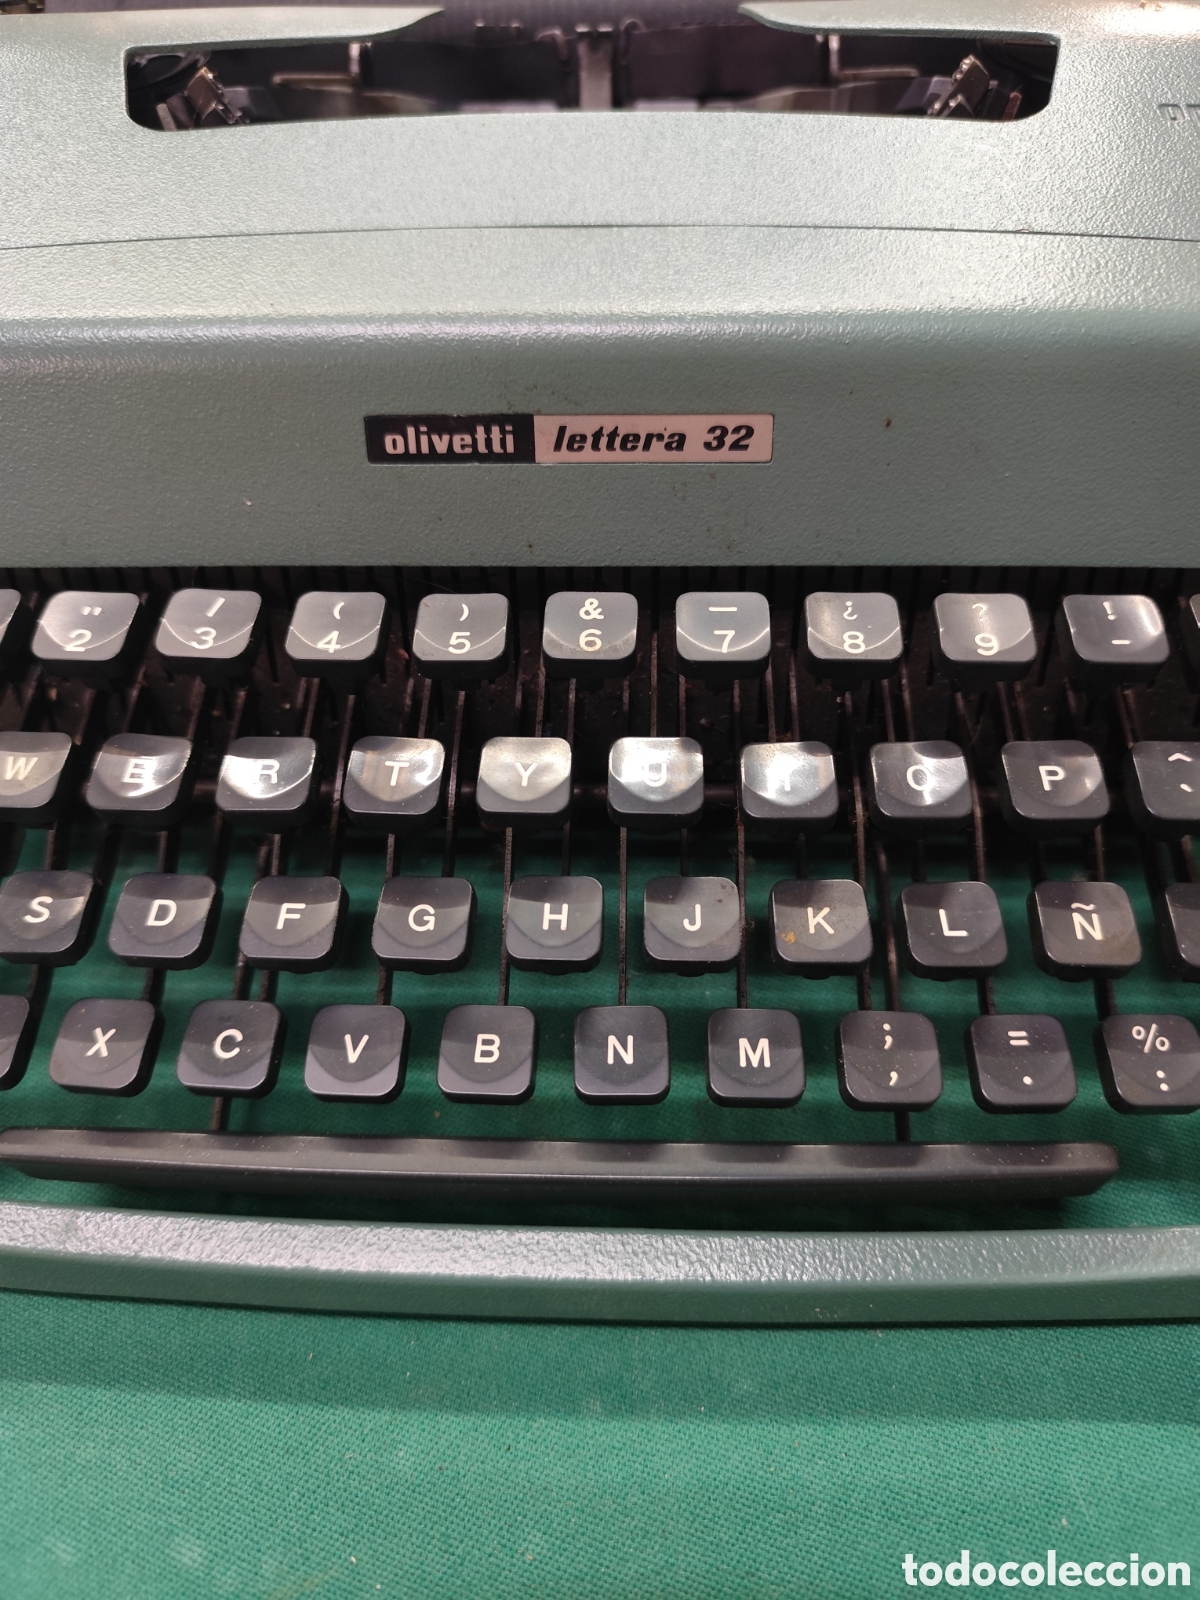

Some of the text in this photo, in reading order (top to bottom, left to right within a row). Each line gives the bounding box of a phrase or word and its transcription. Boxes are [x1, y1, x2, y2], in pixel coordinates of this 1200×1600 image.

[384, 424, 515, 455] olivetti
[553, 425, 755, 452] lettera 32
[333, 601, 345, 619] (
[460, 604, 469, 622] )
[578, 597, 605, 620] &
[843, 600, 858, 620] ¿
[1102, 601, 1116, 620] !
[65, 629, 92, 652] 2
[191, 627, 217, 650] 3
[317, 630, 341, 653] 4
[448, 631, 471, 654] 5
[578, 629, 602, 652] 6
[712, 630, 735, 653] 7
[842, 631, 866, 654] 8
[974, 633, 999, 656] 9
[3, 756, 38, 780] W
[122, 758, 151, 783] E
[253, 758, 279, 783] R
[384, 761, 410, 786] T
[514, 761, 538, 787] Y
[906, 766, 931, 792] O
[1038, 765, 1065, 791] P
[23, 896, 53, 923] S
[146, 899, 177, 927] D
[276, 903, 307, 930] F
[407, 905, 436, 931] G
[542, 903, 568, 930] H
[682, 904, 701, 932] J
[807, 907, 835, 934] K
[1070, 903, 1104, 941] Ñ
[938, 909, 968, 937] L
[85, 1028, 116, 1058] X
[212, 1028, 244, 1059] C
[343, 1034, 369, 1063] V
[473, 1034, 501, 1063] B
[882, 1022, 892, 1050] ;
[1132, 1023, 1170, 1053] %
[607, 1035, 634, 1065] N
[739, 1038, 771, 1068] M
